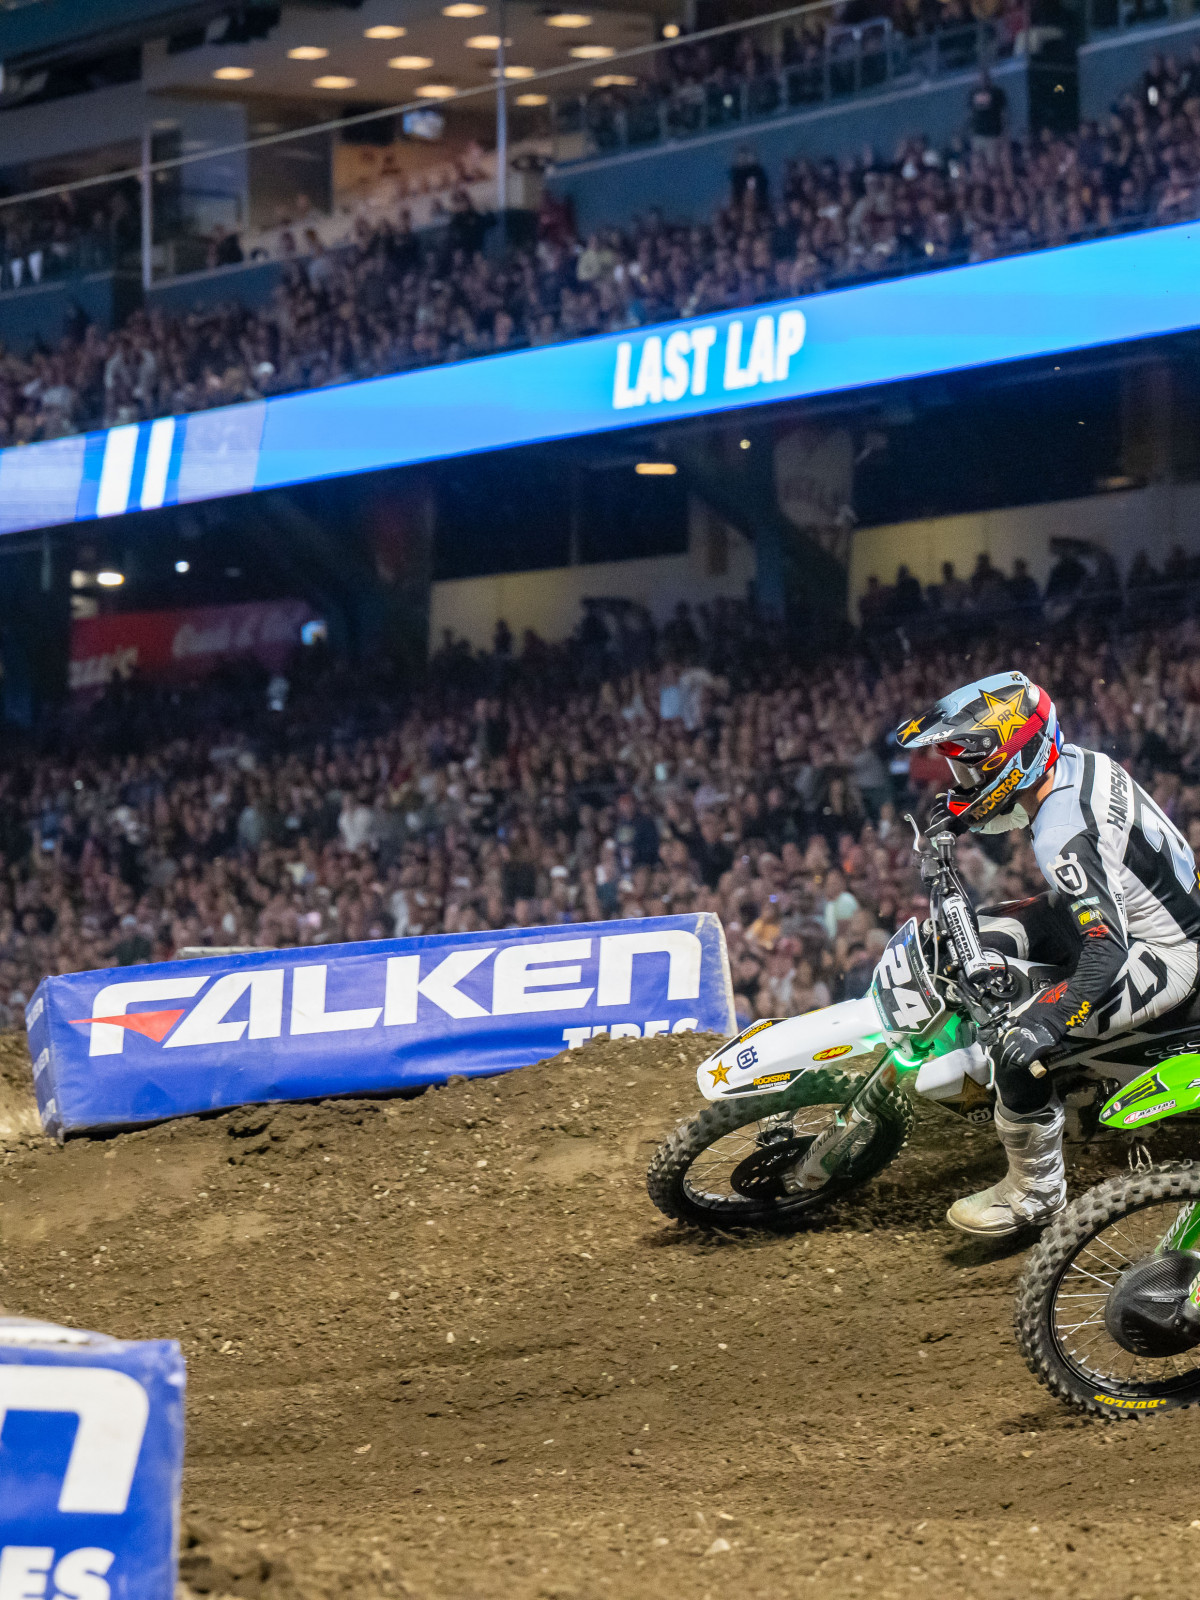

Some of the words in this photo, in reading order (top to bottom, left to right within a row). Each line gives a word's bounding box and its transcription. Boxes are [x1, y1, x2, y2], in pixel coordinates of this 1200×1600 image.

[612, 325, 717, 410] LAST
[723, 309, 807, 391] LAP
[970, 768, 1025, 820] ROCKSTAR
[89, 929, 703, 1057] FALKEN
[878, 943, 932, 1030] 24
[816, 1046, 852, 1060] FMF
[753, 1073, 791, 1086] ROCKSTAR
[1093, 1394, 1160, 1409] DUNLOP
